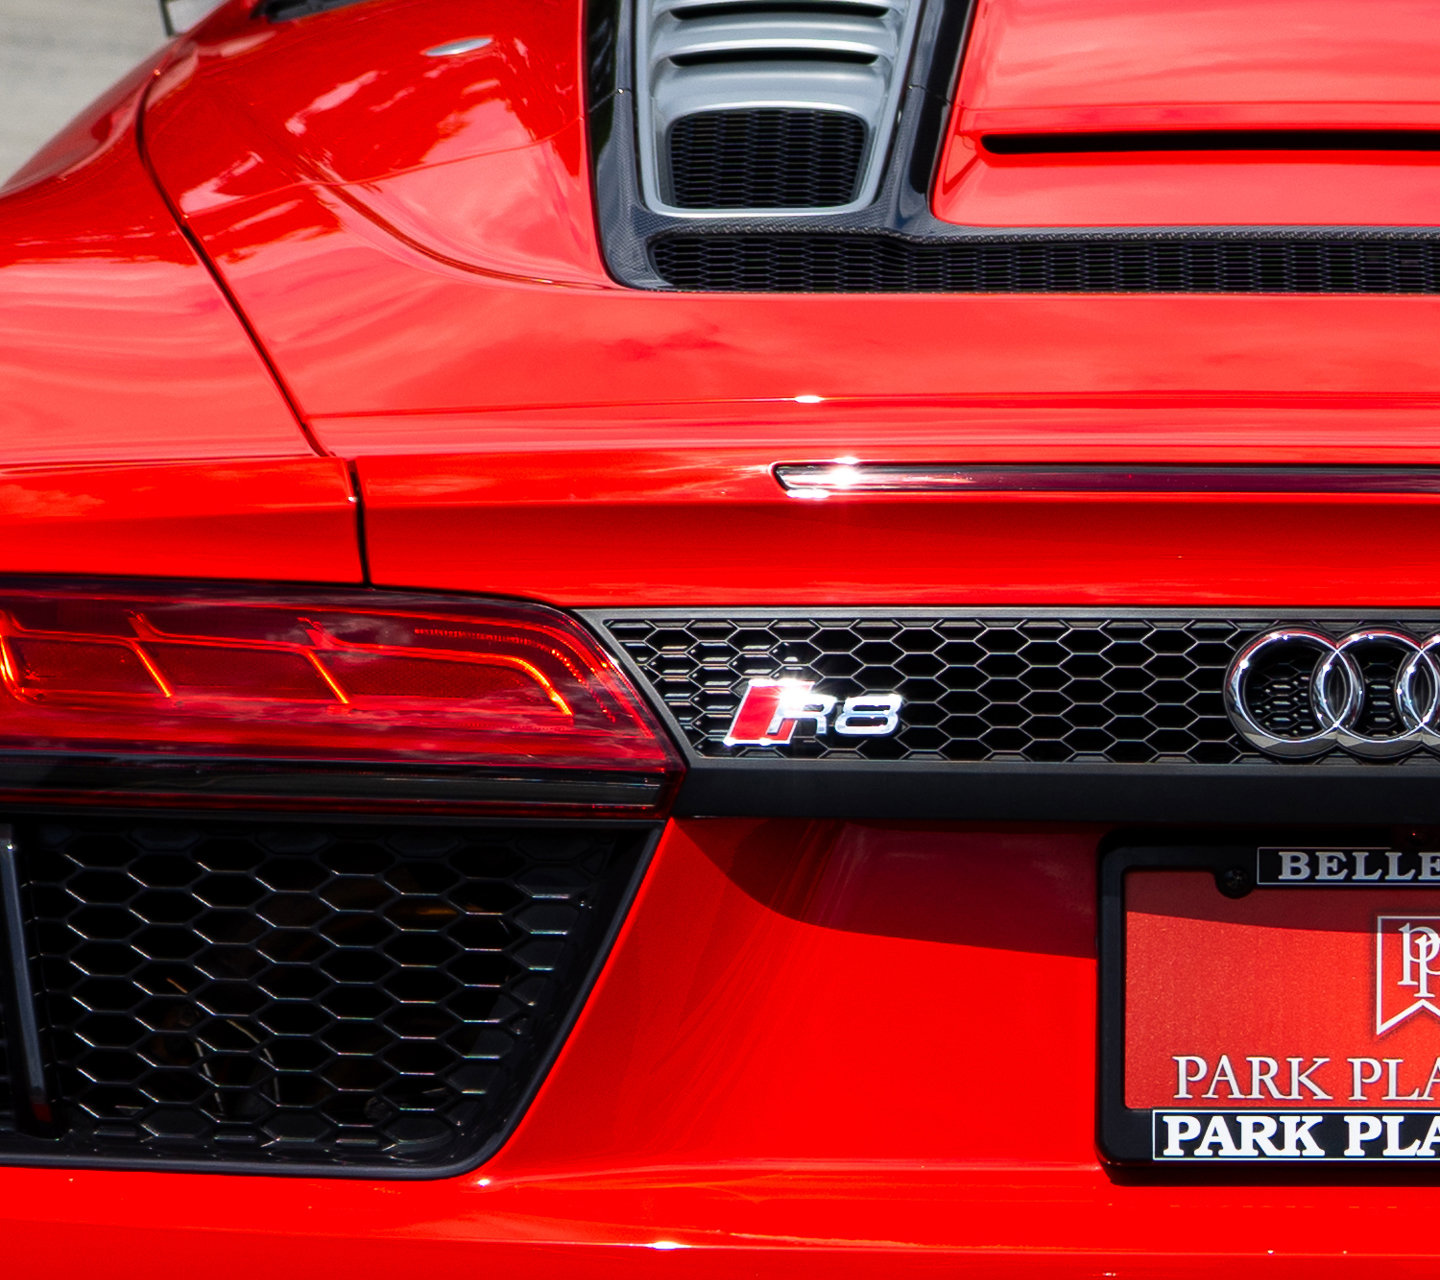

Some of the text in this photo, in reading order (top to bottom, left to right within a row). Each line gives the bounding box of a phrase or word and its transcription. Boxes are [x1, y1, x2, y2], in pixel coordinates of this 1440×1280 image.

[767, 693, 903, 735] R8
[1172, 1055, 1333, 1099] PARK
[1163, 1115, 1324, 1157] PARK
